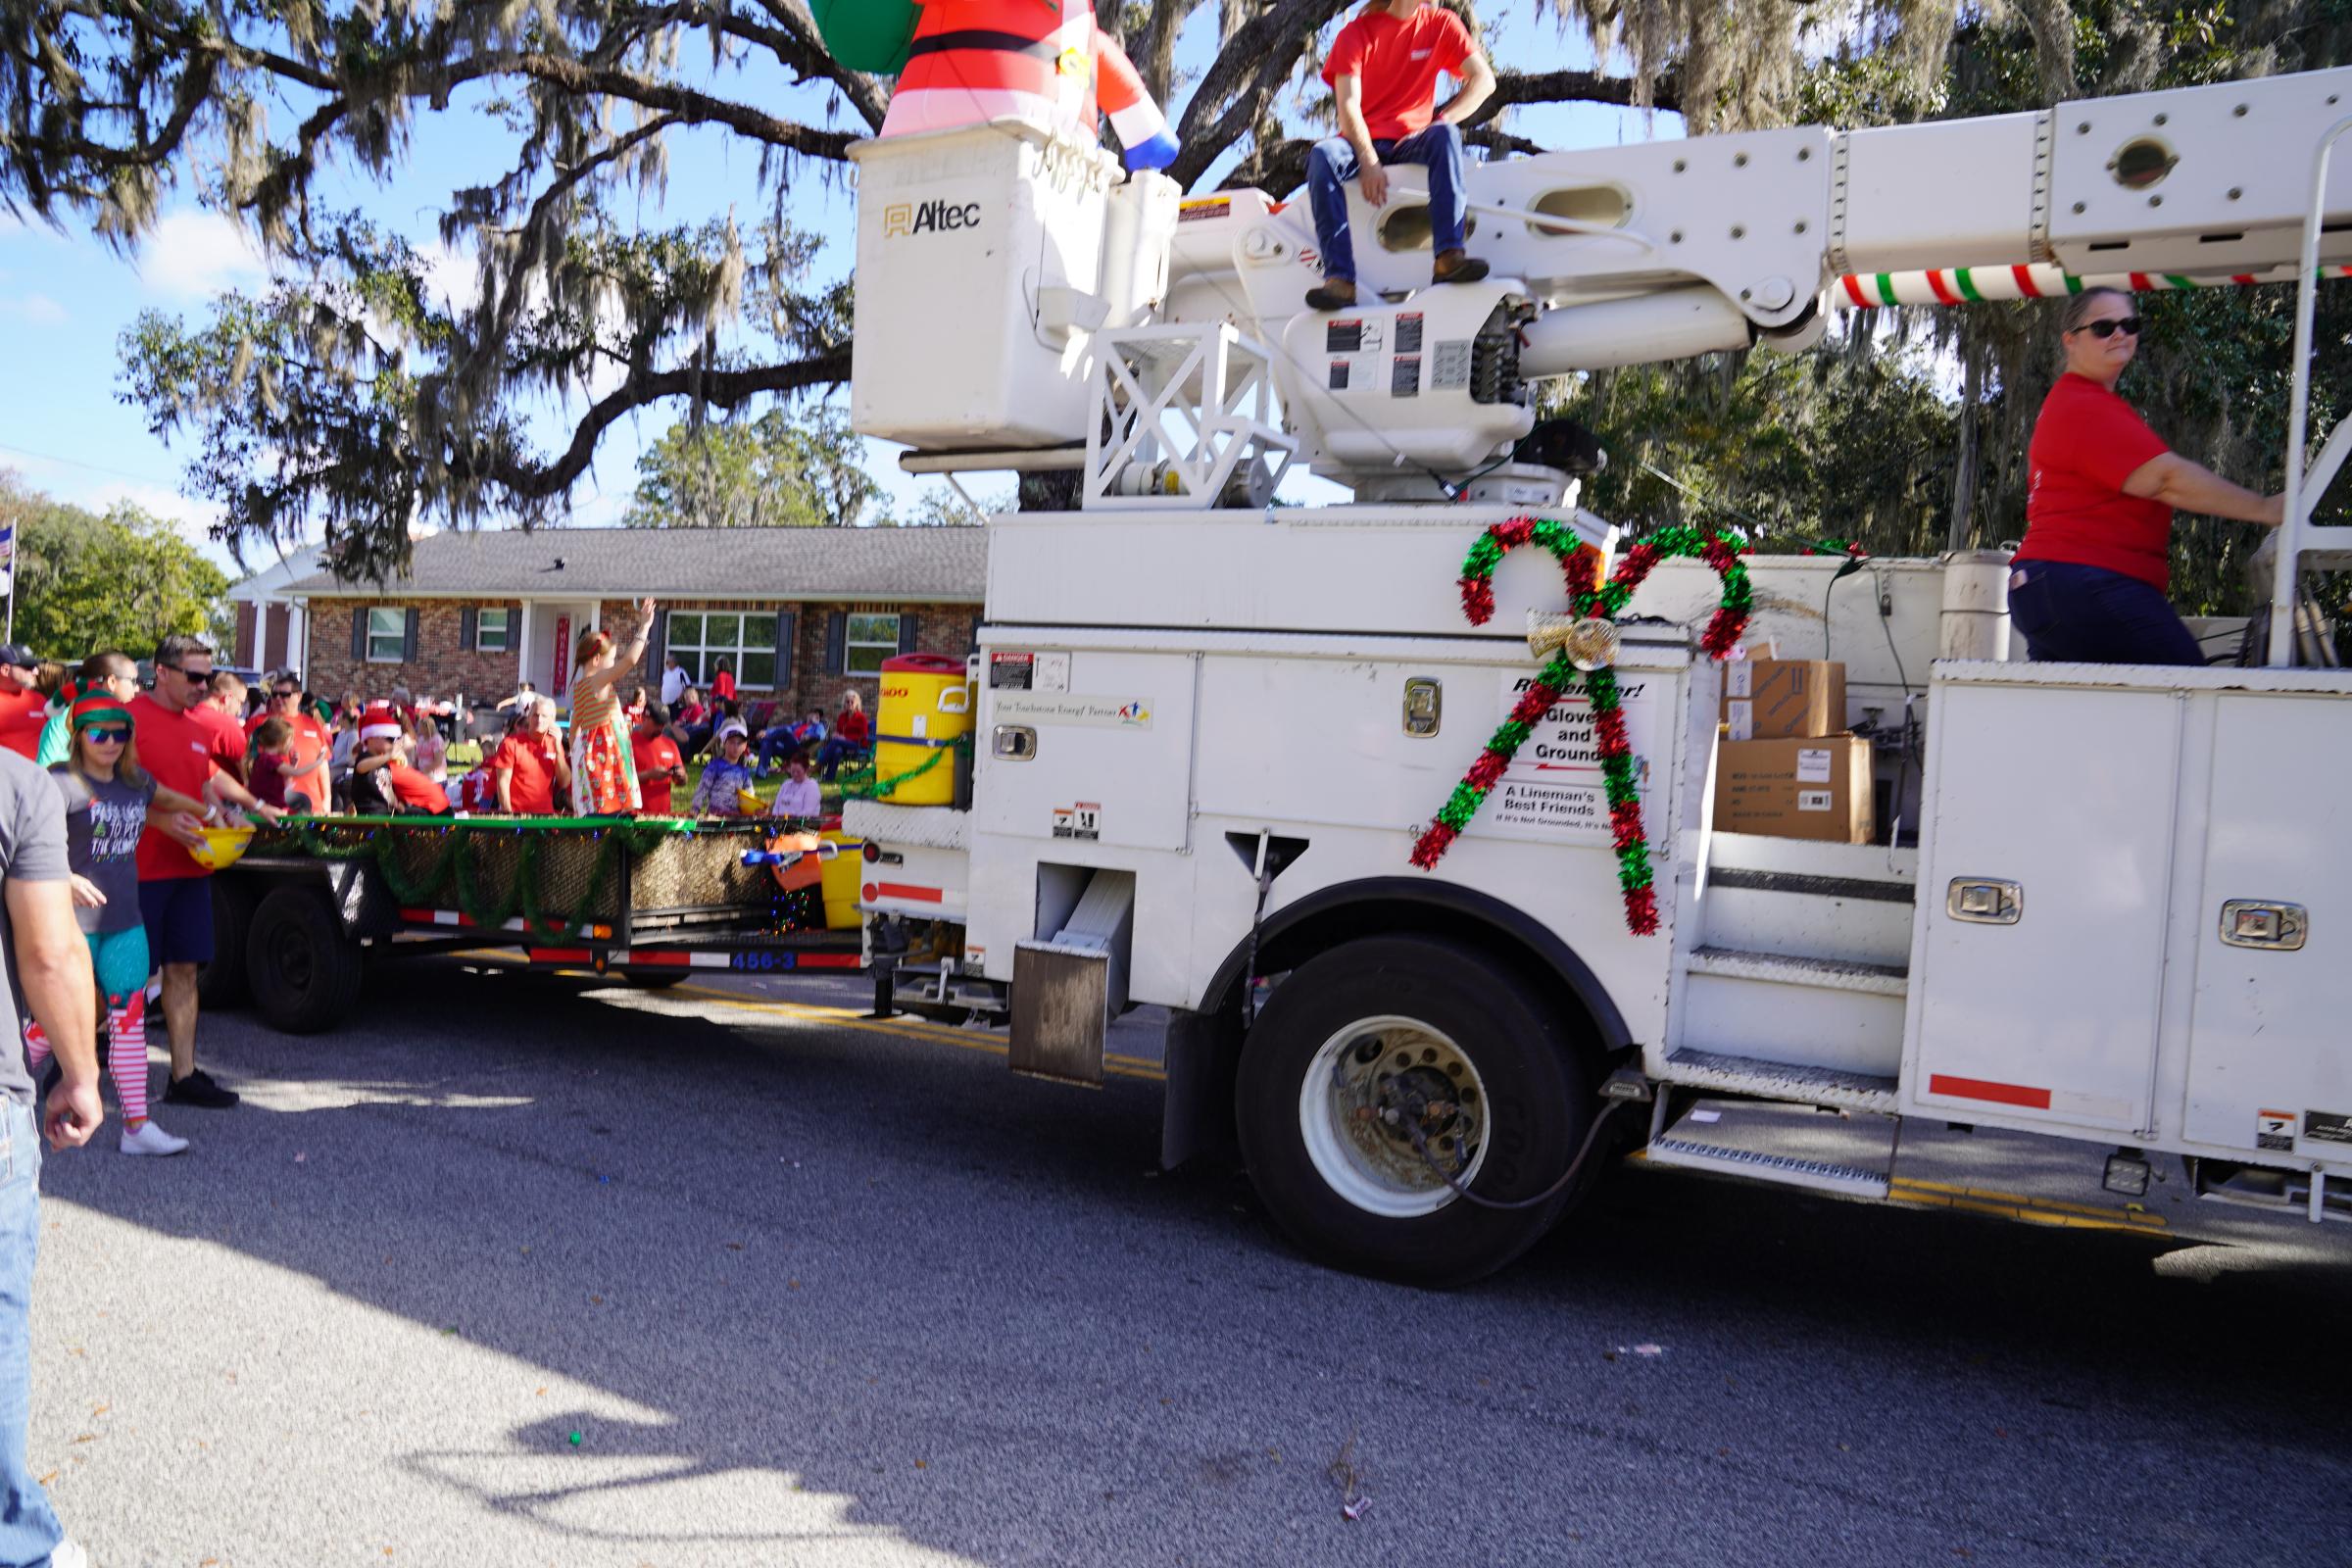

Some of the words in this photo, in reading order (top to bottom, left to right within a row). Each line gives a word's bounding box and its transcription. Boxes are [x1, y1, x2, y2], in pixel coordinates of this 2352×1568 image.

[912, 199, 980, 234] Altec
[1546, 708, 1596, 724] Glove
[1557, 729, 1591, 742] and
[1536, 744, 1602, 761] Ground
[1505, 785, 1516, 797] A
[1520, 787, 1595, 803] Lineman's
[1504, 799, 1537, 811] Best
[1540, 802, 1595, 816] Friends
[732, 951, 795, 970] 456-3
